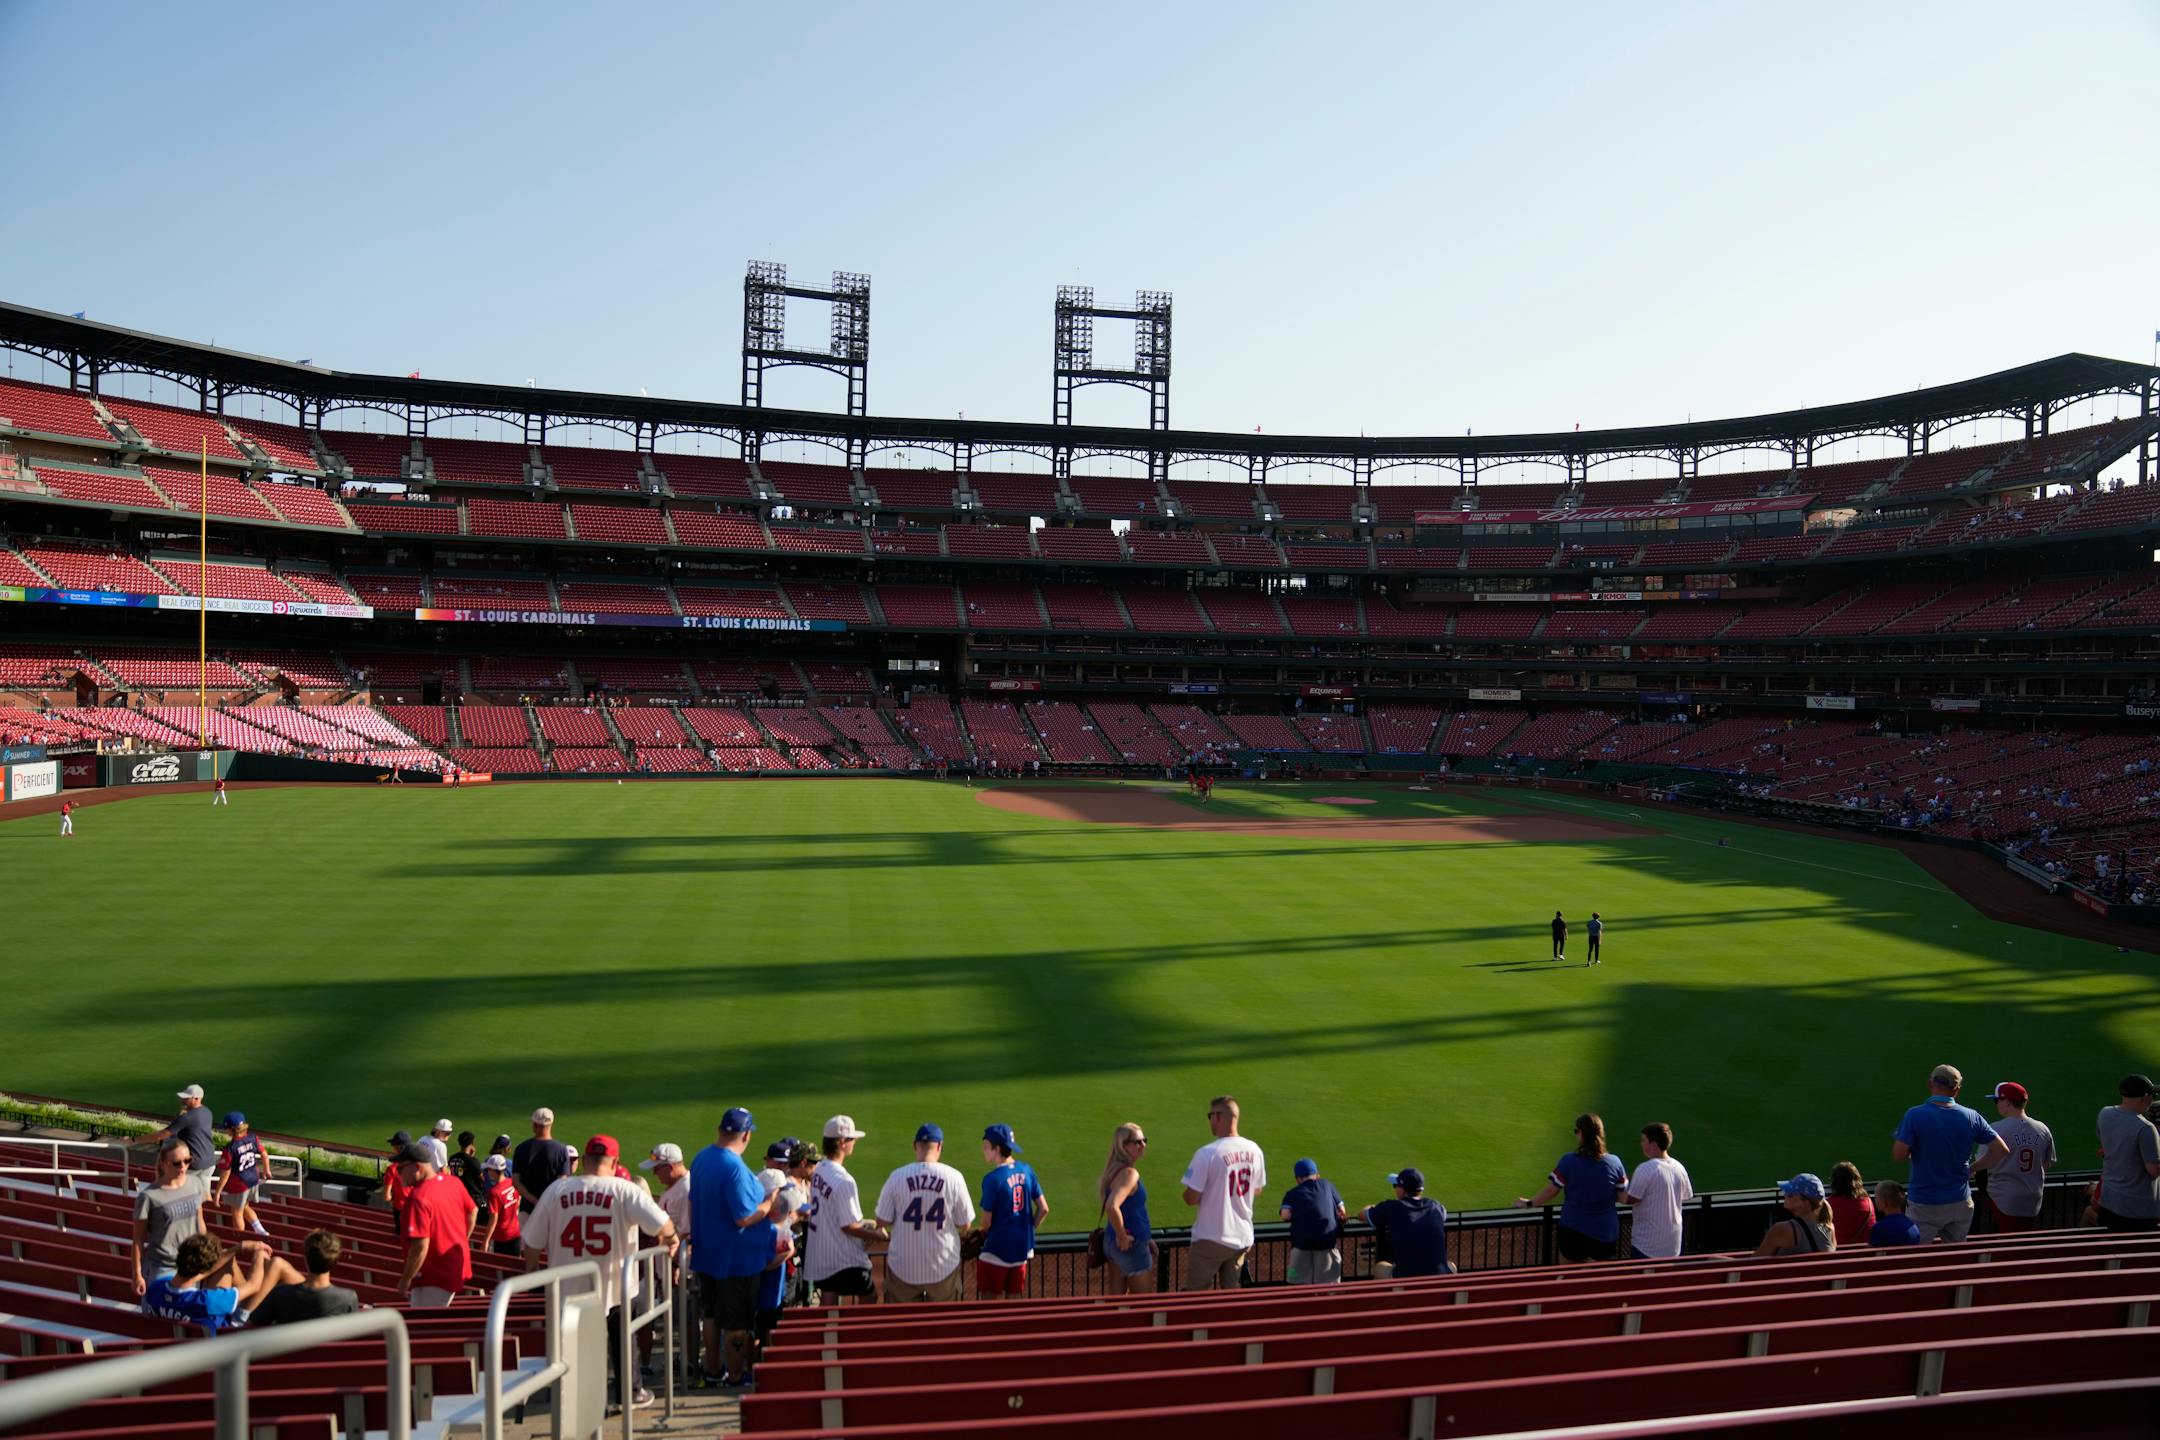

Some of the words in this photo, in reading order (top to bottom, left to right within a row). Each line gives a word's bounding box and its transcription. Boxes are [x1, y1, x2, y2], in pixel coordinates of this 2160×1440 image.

[1537, 506, 1692, 521] Budweiser
[161, 597, 178, 607] REAL
[289, 605, 322, 615] Rewards
[454, 611, 475, 621] ST.
[479, 611, 518, 622] LOUIS
[521, 612, 596, 624] CARDINALS
[683, 617, 702, 627] ST.
[705, 617, 741, 628] LOUIS
[743, 618, 811, 630] CARDINALS
[1309, 687, 1344, 695] EQUIFAX
[13, 772, 54, 791] PERFICIENT
[1223, 1151, 1254, 1167] DUNCAN
[2019, 1147, 2034, 1172] 9
[906, 1174, 945, 1193] RIZZO
[560, 1190, 613, 1209] GIBSON
[903, 1196, 946, 1231] 44
[560, 1215, 612, 1257] 45
